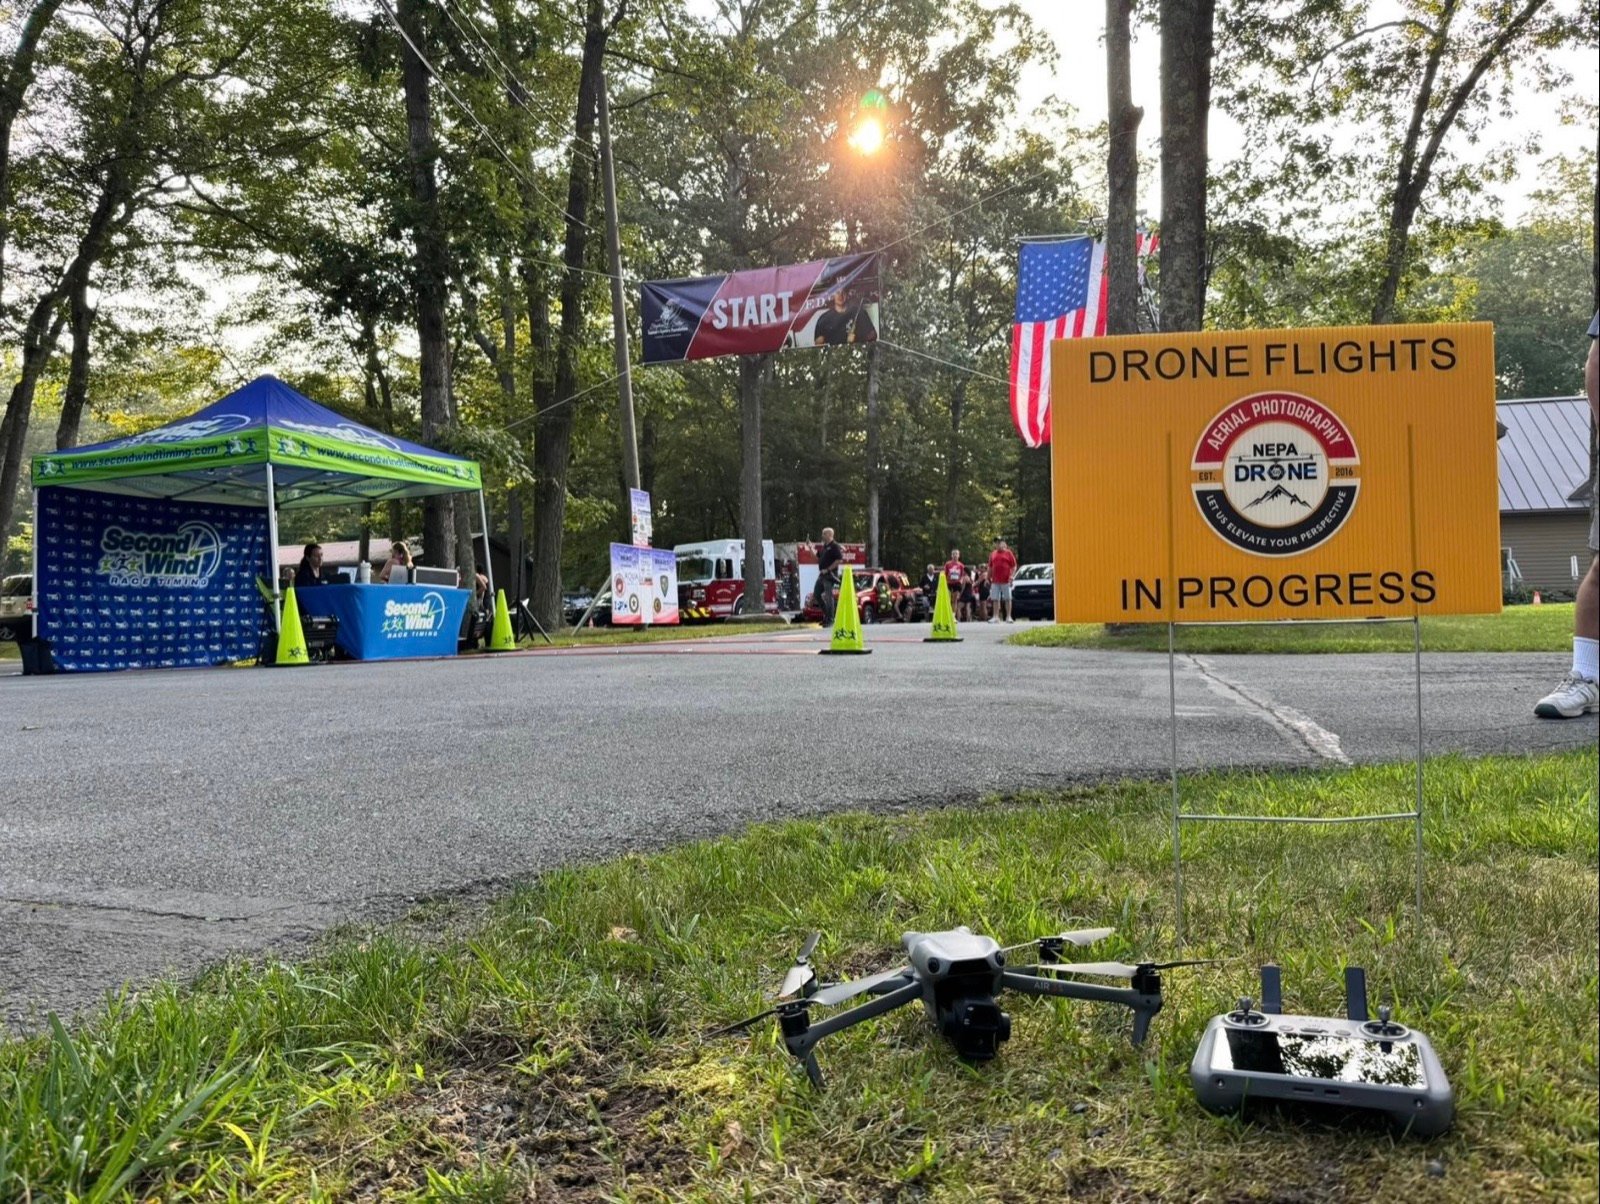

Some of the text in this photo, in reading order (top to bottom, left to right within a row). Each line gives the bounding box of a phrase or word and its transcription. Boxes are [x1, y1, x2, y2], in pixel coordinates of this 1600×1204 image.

[712, 291, 793, 330] START
[1090, 338, 1456, 383] DRONE FLIGHTS
[1207, 399, 1345, 450] AERIAL PHOTOGRAPHY
[72, 444, 218, 470] www.secondwindtiming.com
[1253, 443, 1298, 457] NEPA
[1198, 471, 1216, 481] EST.
[1234, 462, 1317, 482] DRONE
[1335, 467, 1353, 477] 2016
[1206, 490, 1347, 547] LET US ELEVATE YOUR PERSPECTIVE
[102, 526, 193, 554] Second
[143, 552, 203, 575] Wind
[109, 576, 209, 588] RACE TIMING
[1121, 571, 1437, 610] IN PROGRESS
[384, 599, 431, 617] Second
[405, 614, 435, 630] Wind
